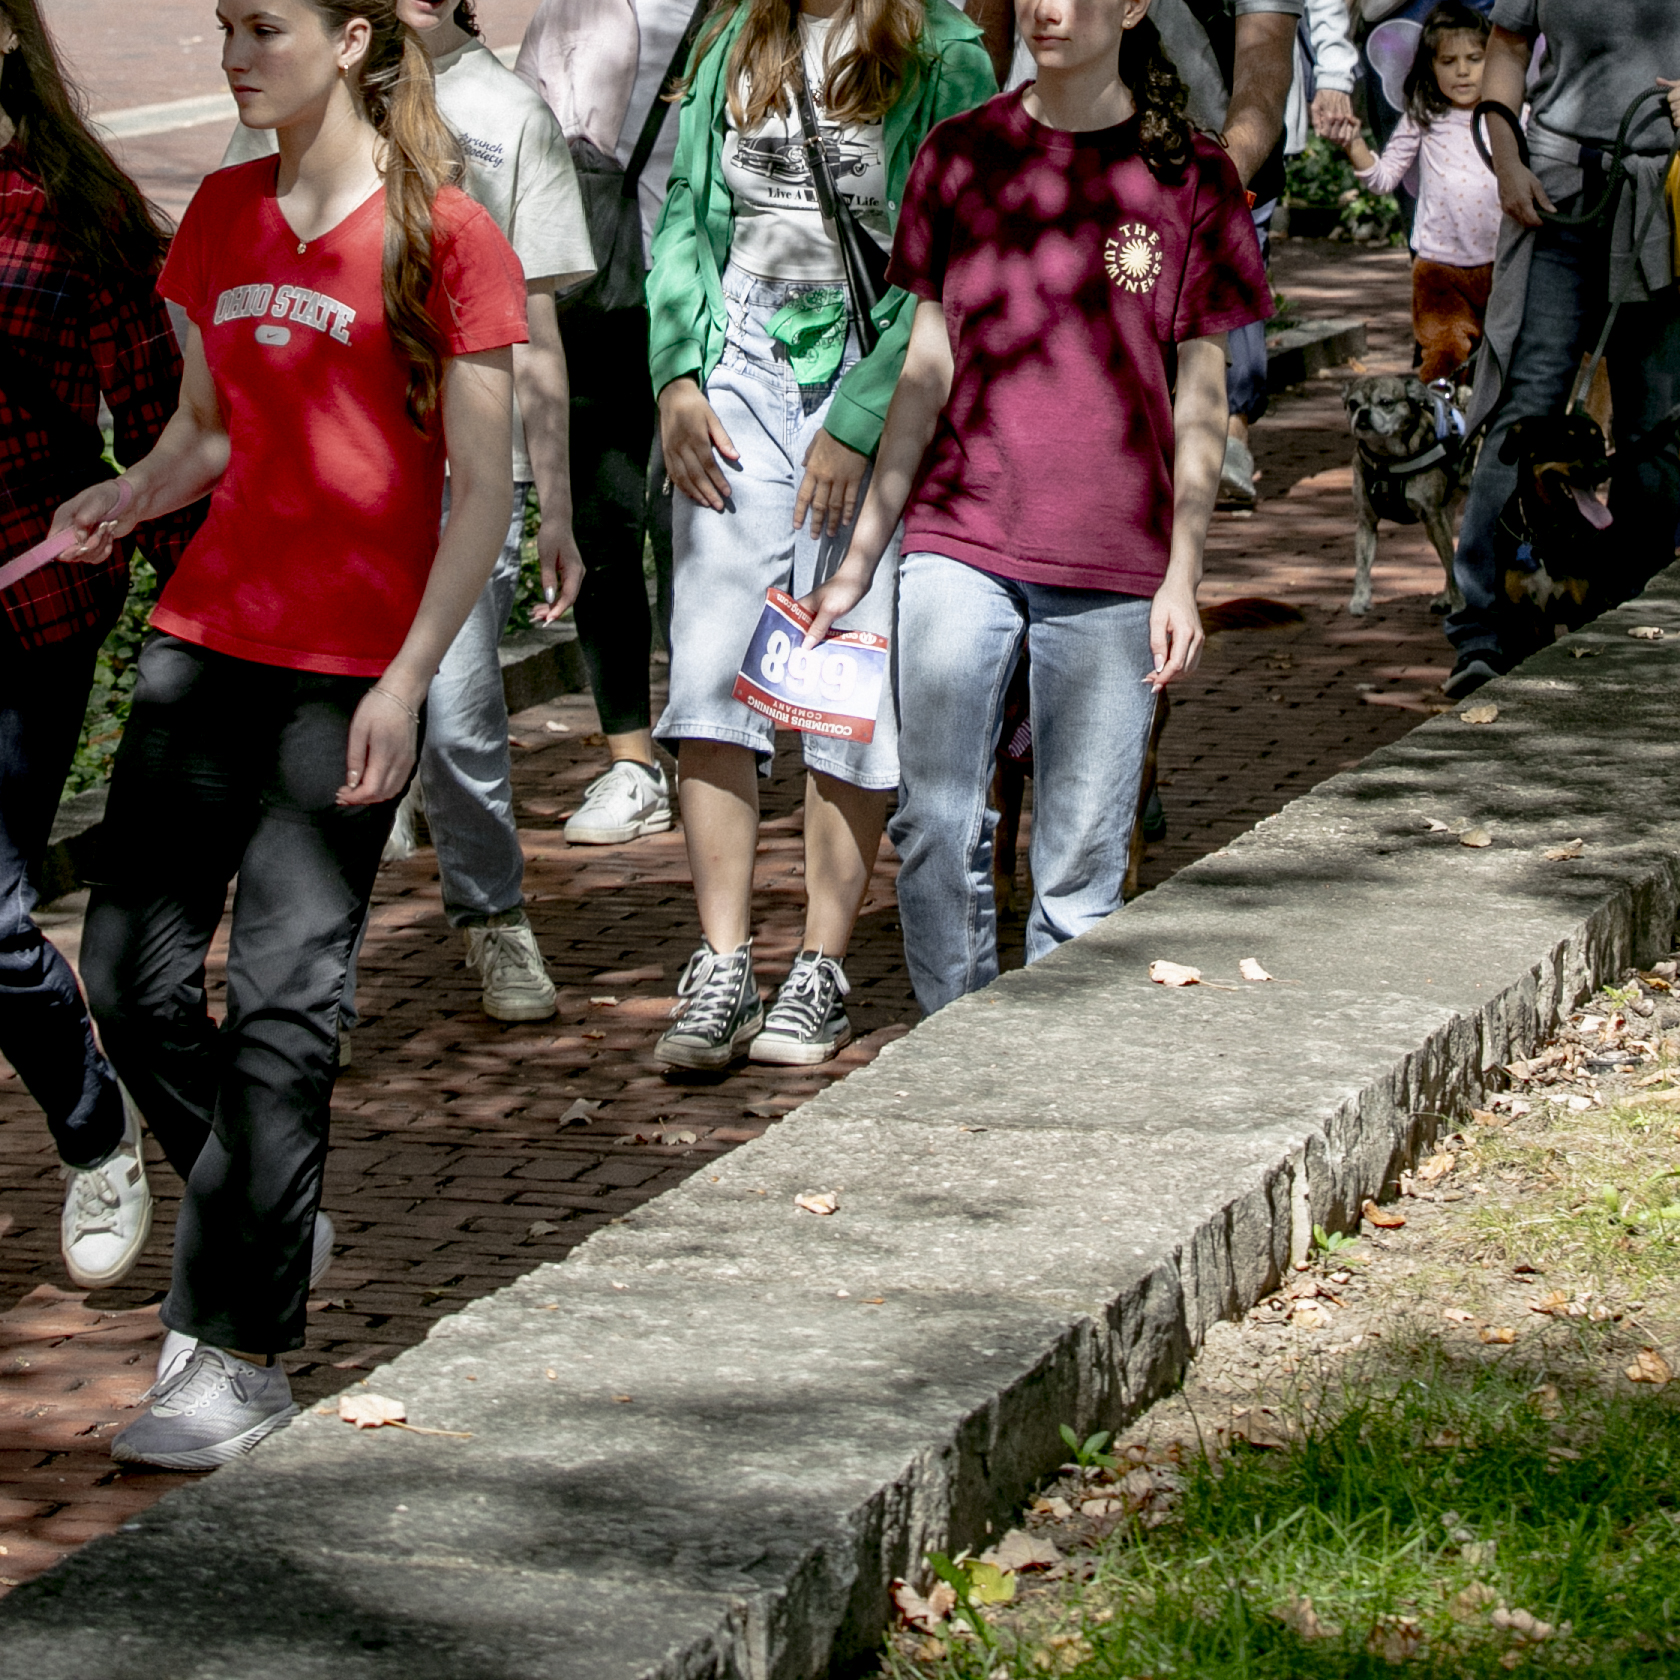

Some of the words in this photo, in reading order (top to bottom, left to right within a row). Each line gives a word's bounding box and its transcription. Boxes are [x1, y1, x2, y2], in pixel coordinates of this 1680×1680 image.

[768, 187, 796, 200] Live
[857, 195, 880, 207] Life
[1118, 222, 1160, 246] THE
[213, 283, 274, 326] OHIO
[271, 284, 357, 345] STATE
[760, 629, 859, 702] 668
[747, 695, 790, 723] RUNNING
[772, 701, 823, 720] COMPANY
[791, 716, 853, 736] COLUMBUS
